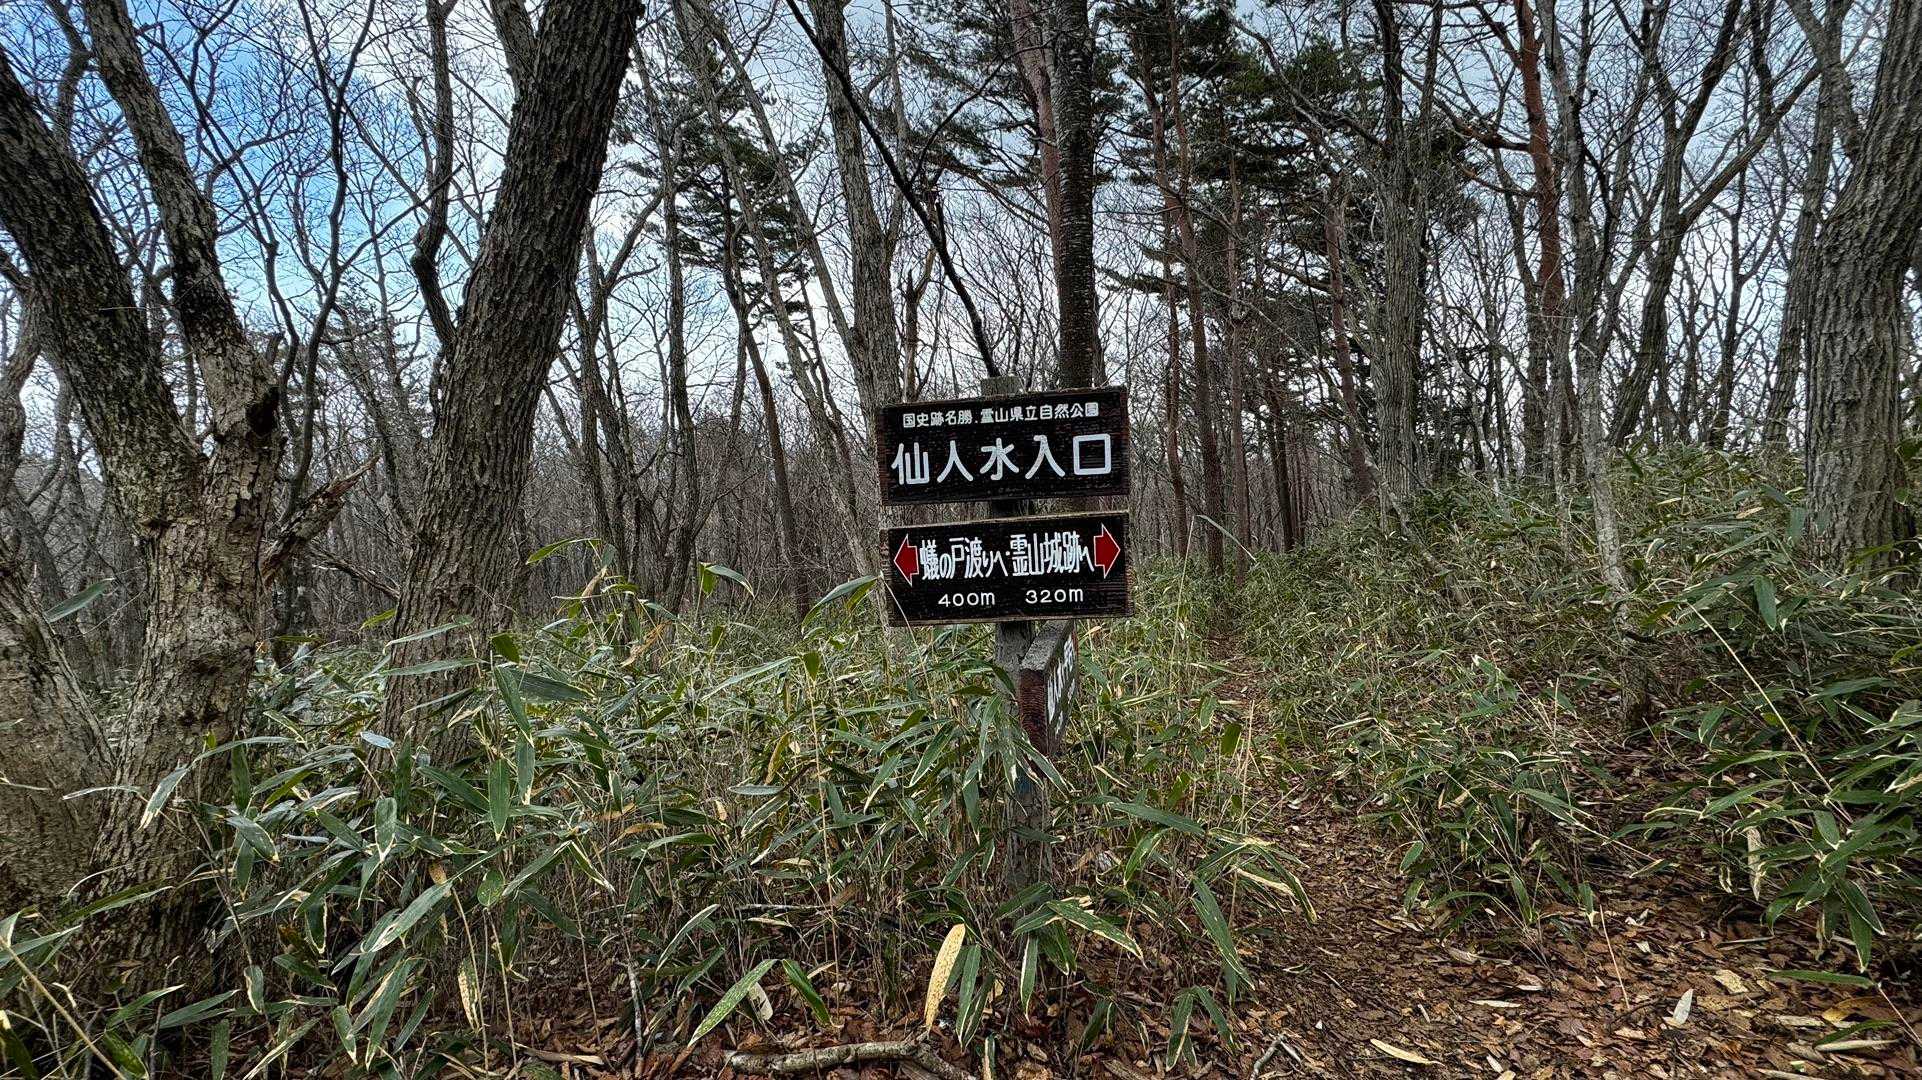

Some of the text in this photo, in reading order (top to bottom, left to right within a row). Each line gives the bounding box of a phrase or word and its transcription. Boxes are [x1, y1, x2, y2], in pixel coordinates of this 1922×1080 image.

[890, 433, 1112, 486] 仙人水入口
[937, 588, 1084, 608] 400m 320m
